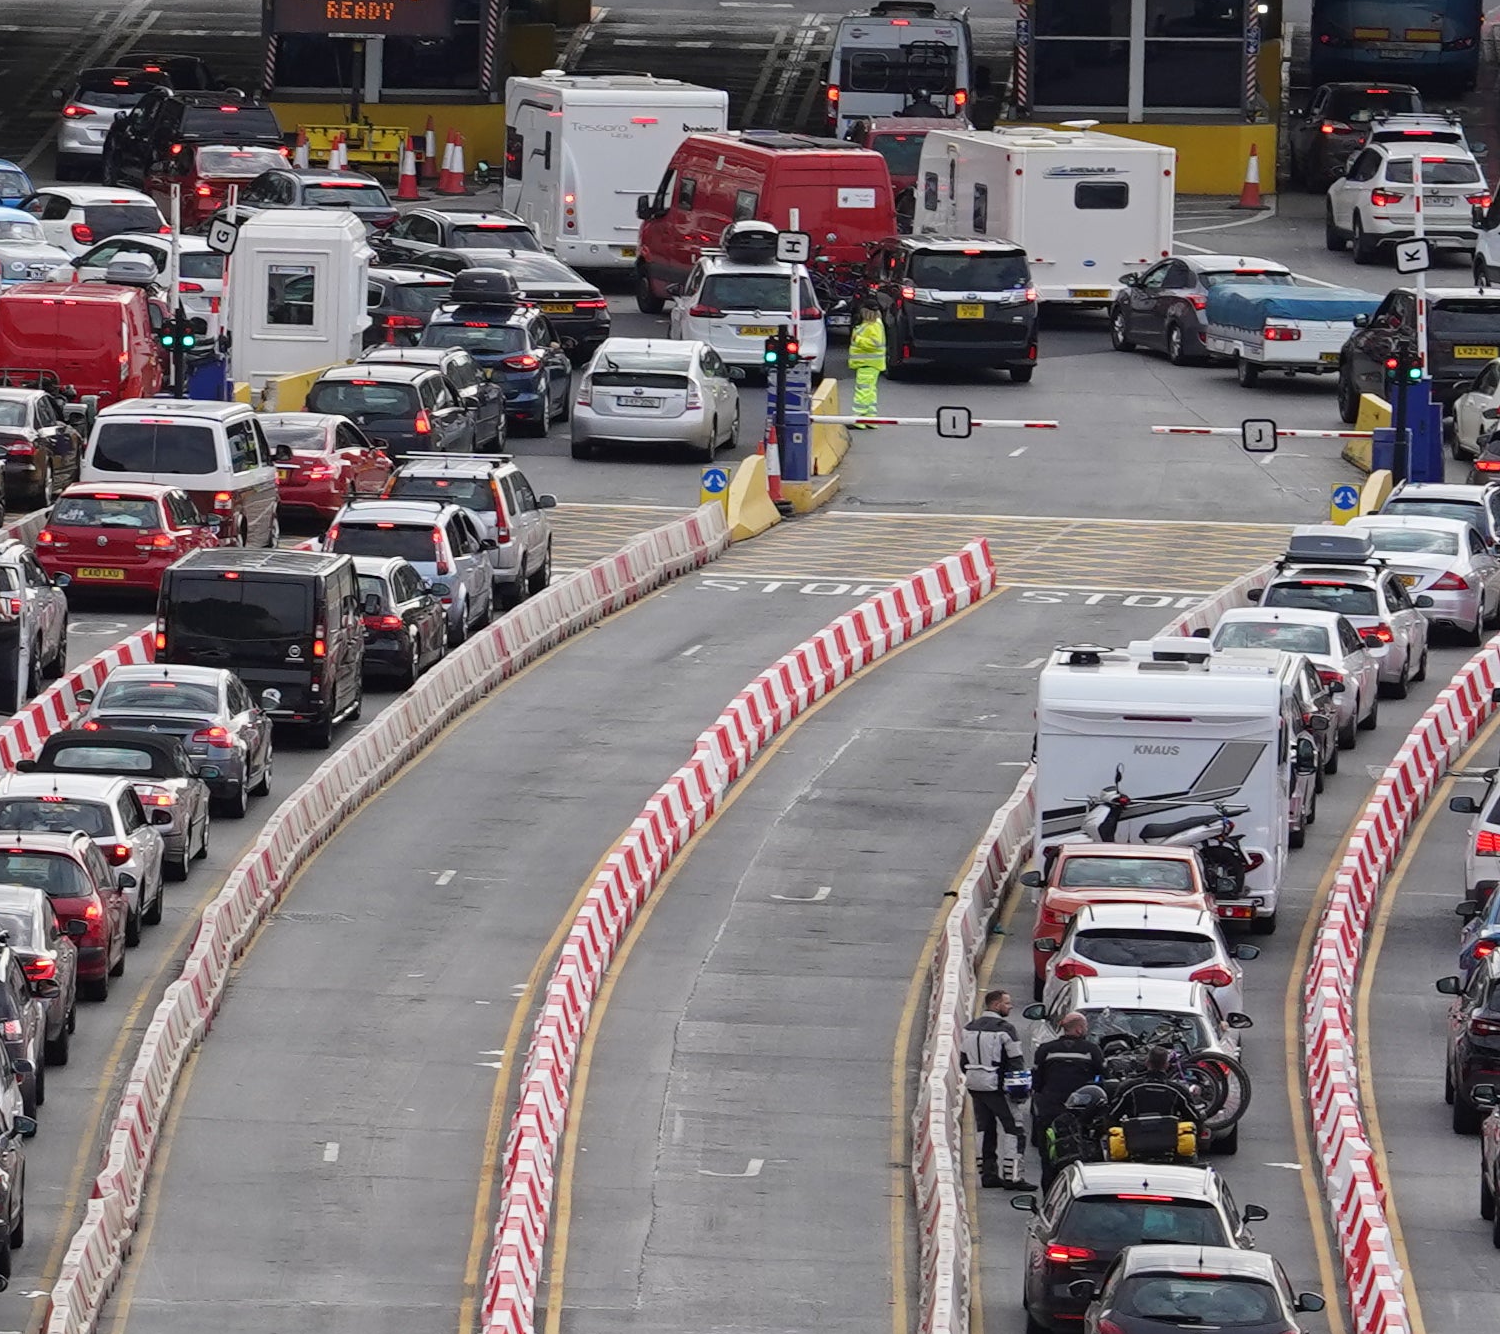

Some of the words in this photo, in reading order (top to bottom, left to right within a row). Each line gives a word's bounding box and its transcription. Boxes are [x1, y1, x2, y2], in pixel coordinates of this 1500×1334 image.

[326, 0, 395, 19] READY
[217, 229, 230, 243] G
[785, 240, 802, 253] H
[1404, 249, 1421, 262] K
[1132, 745, 1181, 756] KNAUS
